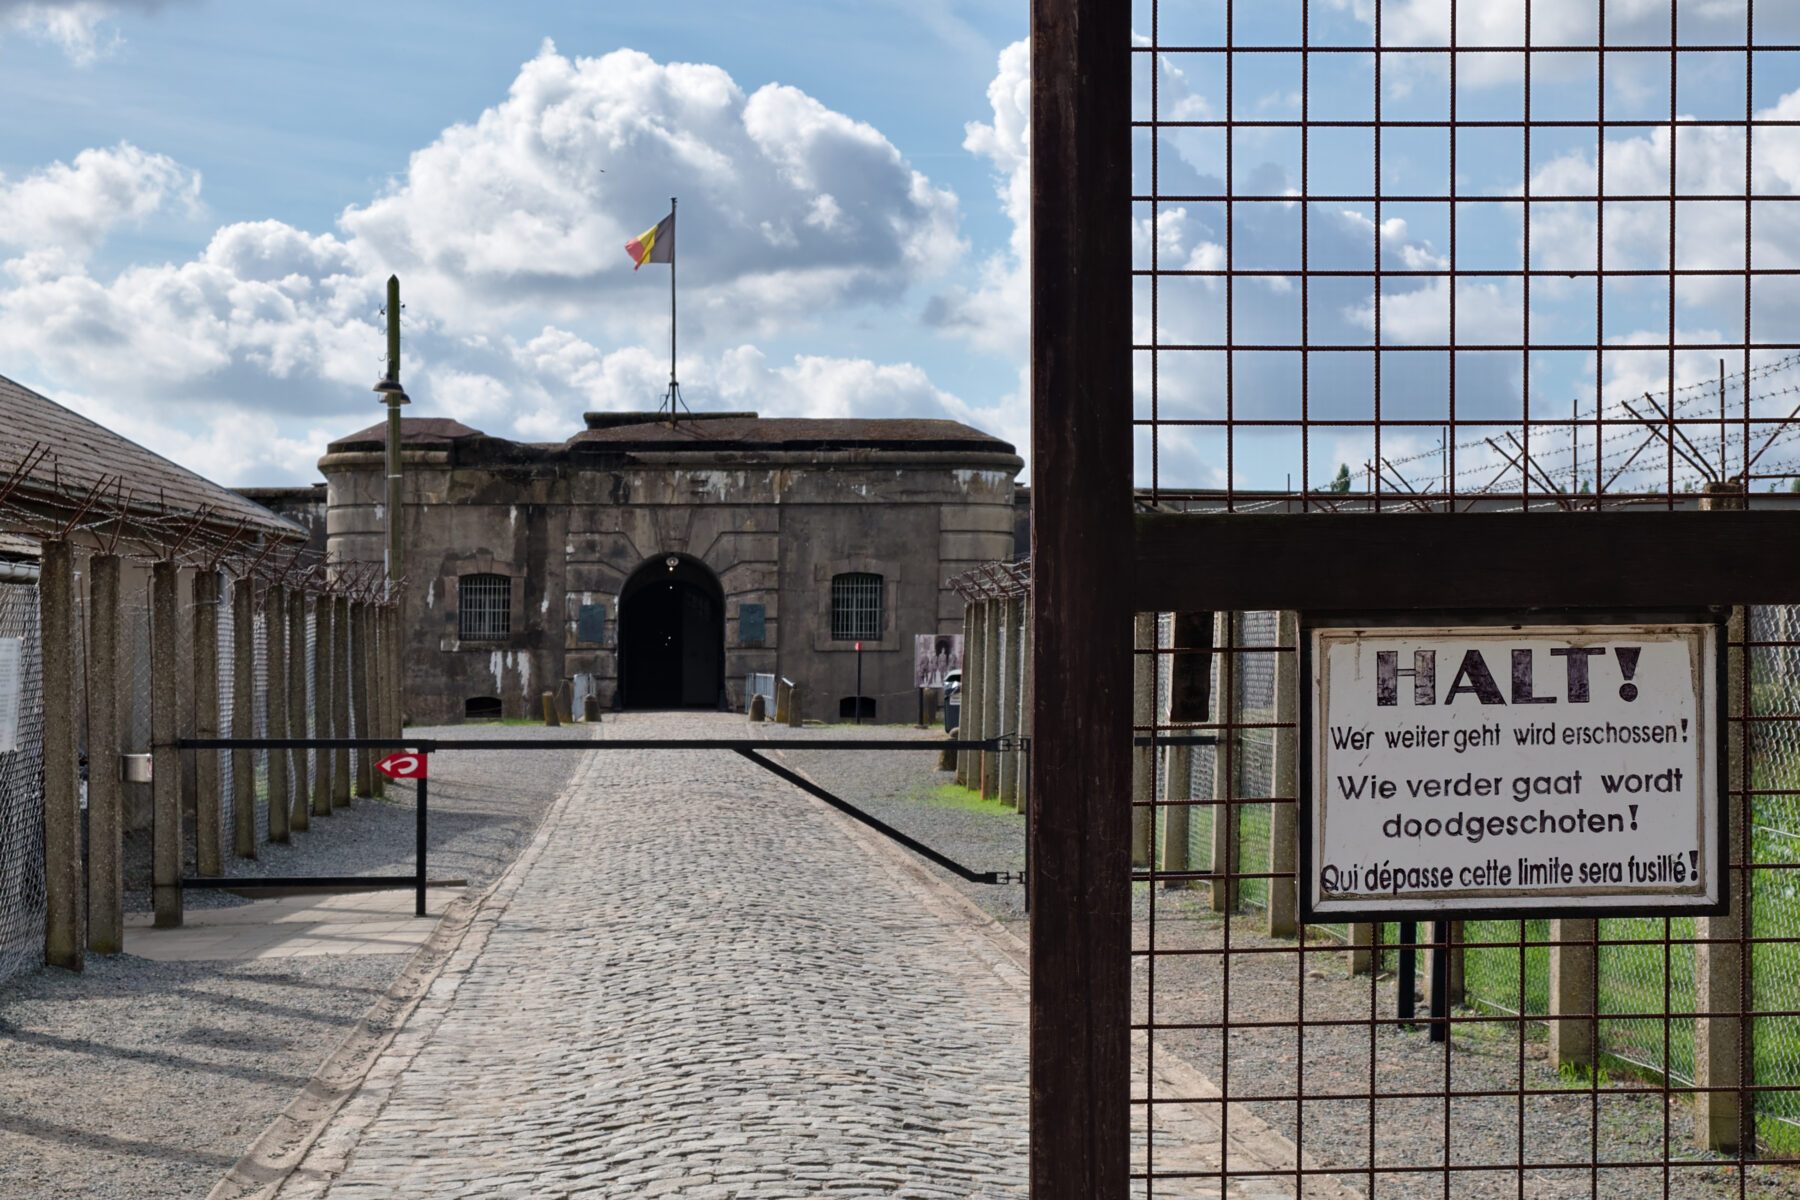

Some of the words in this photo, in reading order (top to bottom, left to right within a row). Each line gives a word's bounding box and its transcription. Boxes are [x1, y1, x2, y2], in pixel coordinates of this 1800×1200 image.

[1376, 646, 1642, 706] HALT!
[1330, 726, 1375, 750] Wer
[1513, 722, 1556, 745] wird
[1562, 718, 1688, 745] erschossen!
[1337, 775, 1397, 800] Wie
[1406, 773, 1503, 798] verder
[1512, 770, 1582, 802] gaat
[1601, 768, 1683, 794] wordt
[1383, 805, 1639, 843] doodgeschoten!
[1320, 864, 1358, 891] Qui
[1364, 860, 1453, 895] dépasse
[1459, 859, 1512, 887] cette
[1518, 856, 1573, 885] limite
[1578, 861, 1623, 884] sera
[1627, 850, 1699, 884] fusillé!
